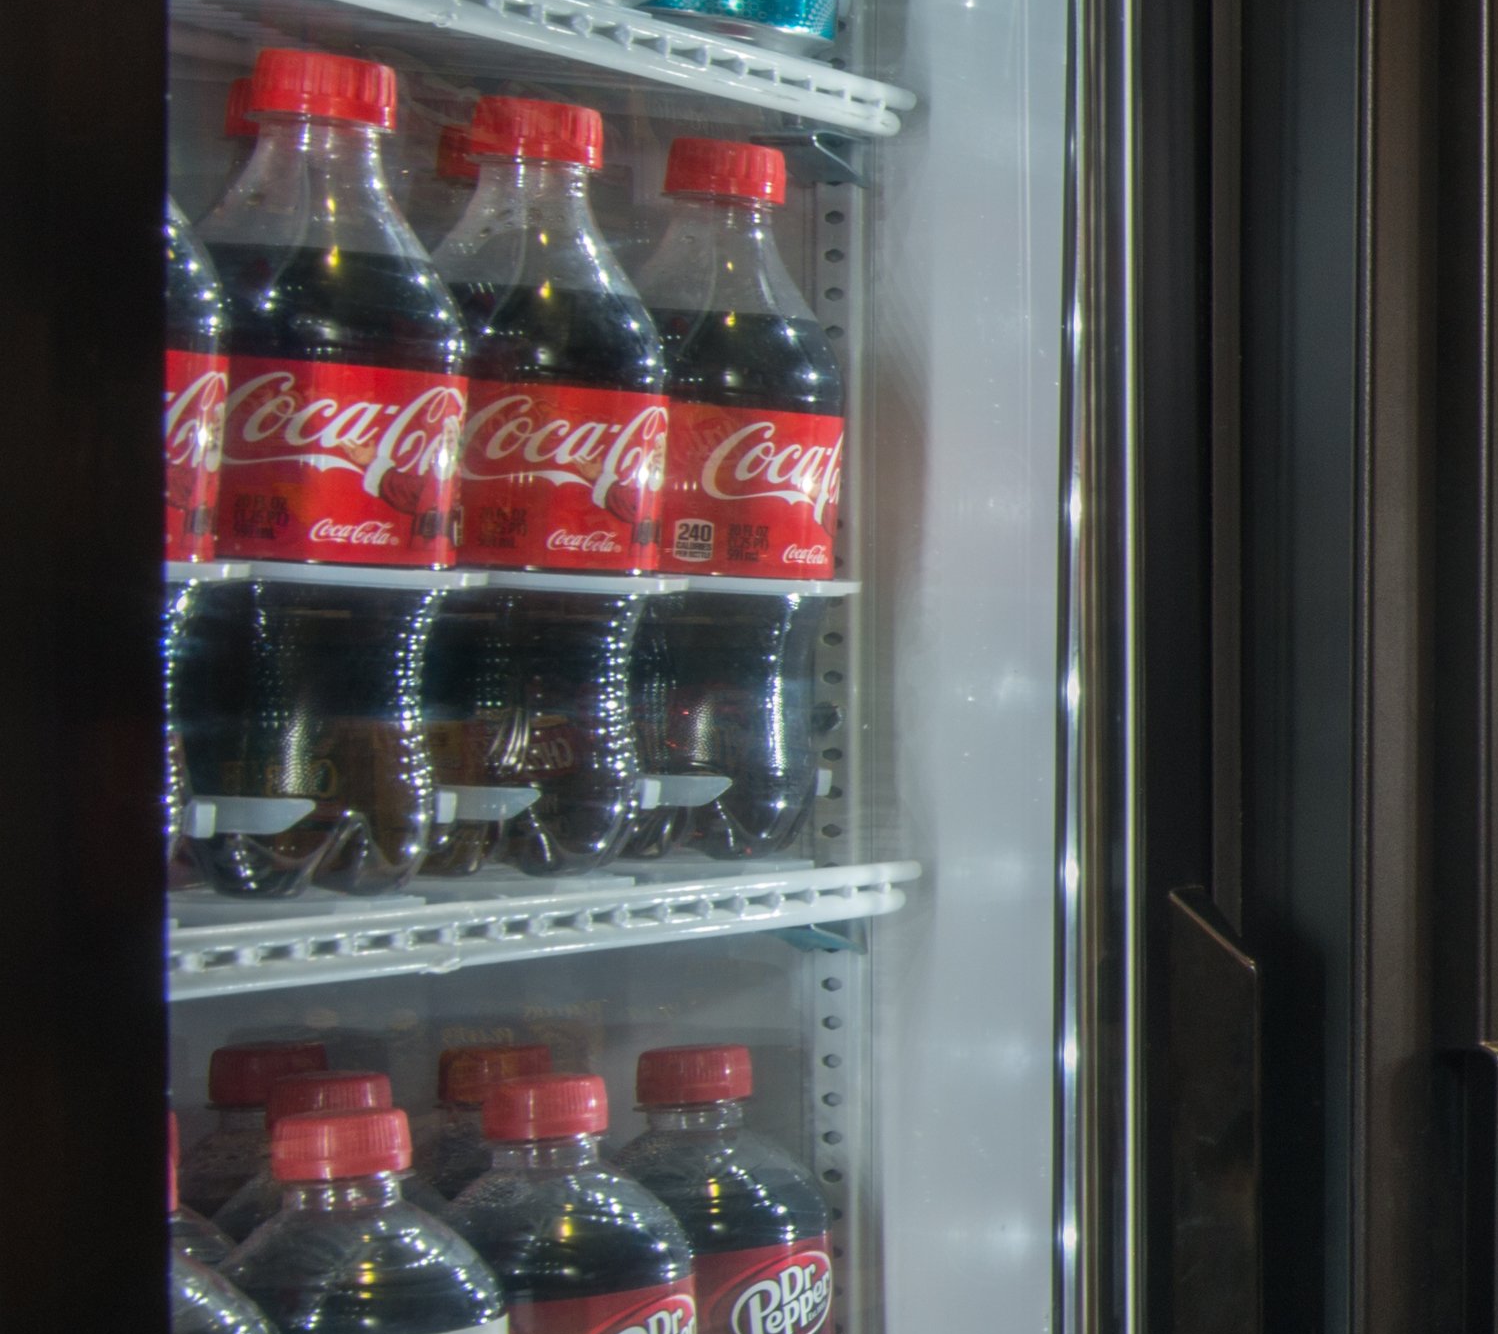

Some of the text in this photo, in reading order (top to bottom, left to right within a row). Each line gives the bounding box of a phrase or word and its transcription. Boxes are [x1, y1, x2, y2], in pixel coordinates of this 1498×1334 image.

[308, 517, 399, 547] Coca-Cola
[546, 528, 622, 555] Coca-Cola
[676, 522, 714, 543] 240
[782, 543, 829, 565] Coca-Cola
[778, 1262, 816, 1300] Dr
